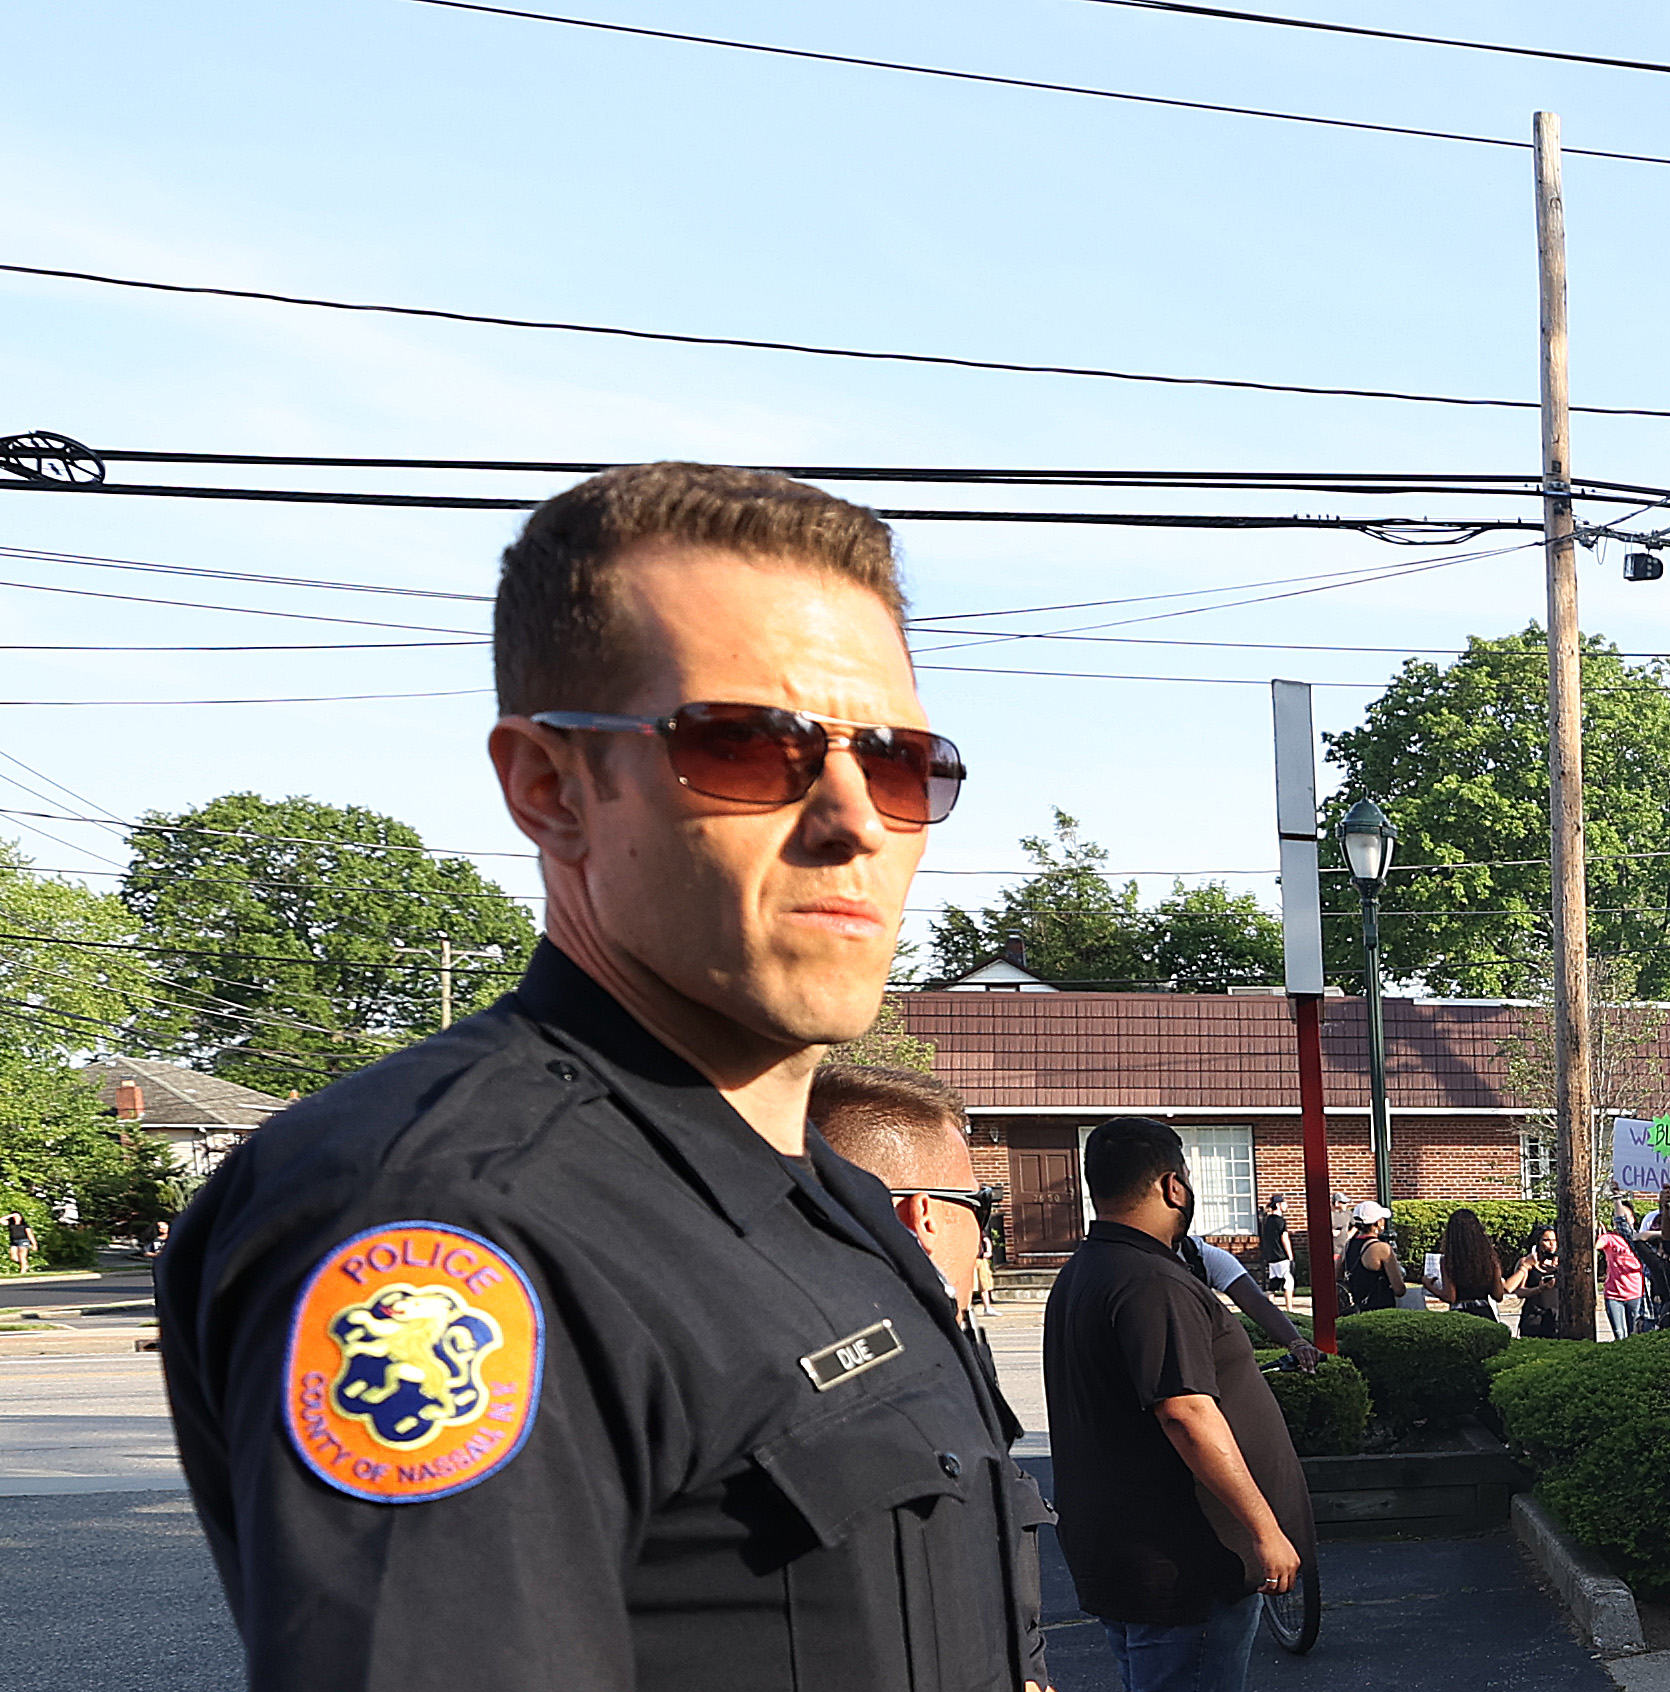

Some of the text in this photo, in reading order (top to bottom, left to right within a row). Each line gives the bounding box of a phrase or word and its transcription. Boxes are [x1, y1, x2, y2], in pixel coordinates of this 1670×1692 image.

[339, 1238, 504, 1297] POLICE
[836, 1338, 875, 1371] DUE
[300, 1371, 353, 1466] COUNTY
[351, 1457, 389, 1483] OF
[397, 1425, 507, 1484] NASSAU
